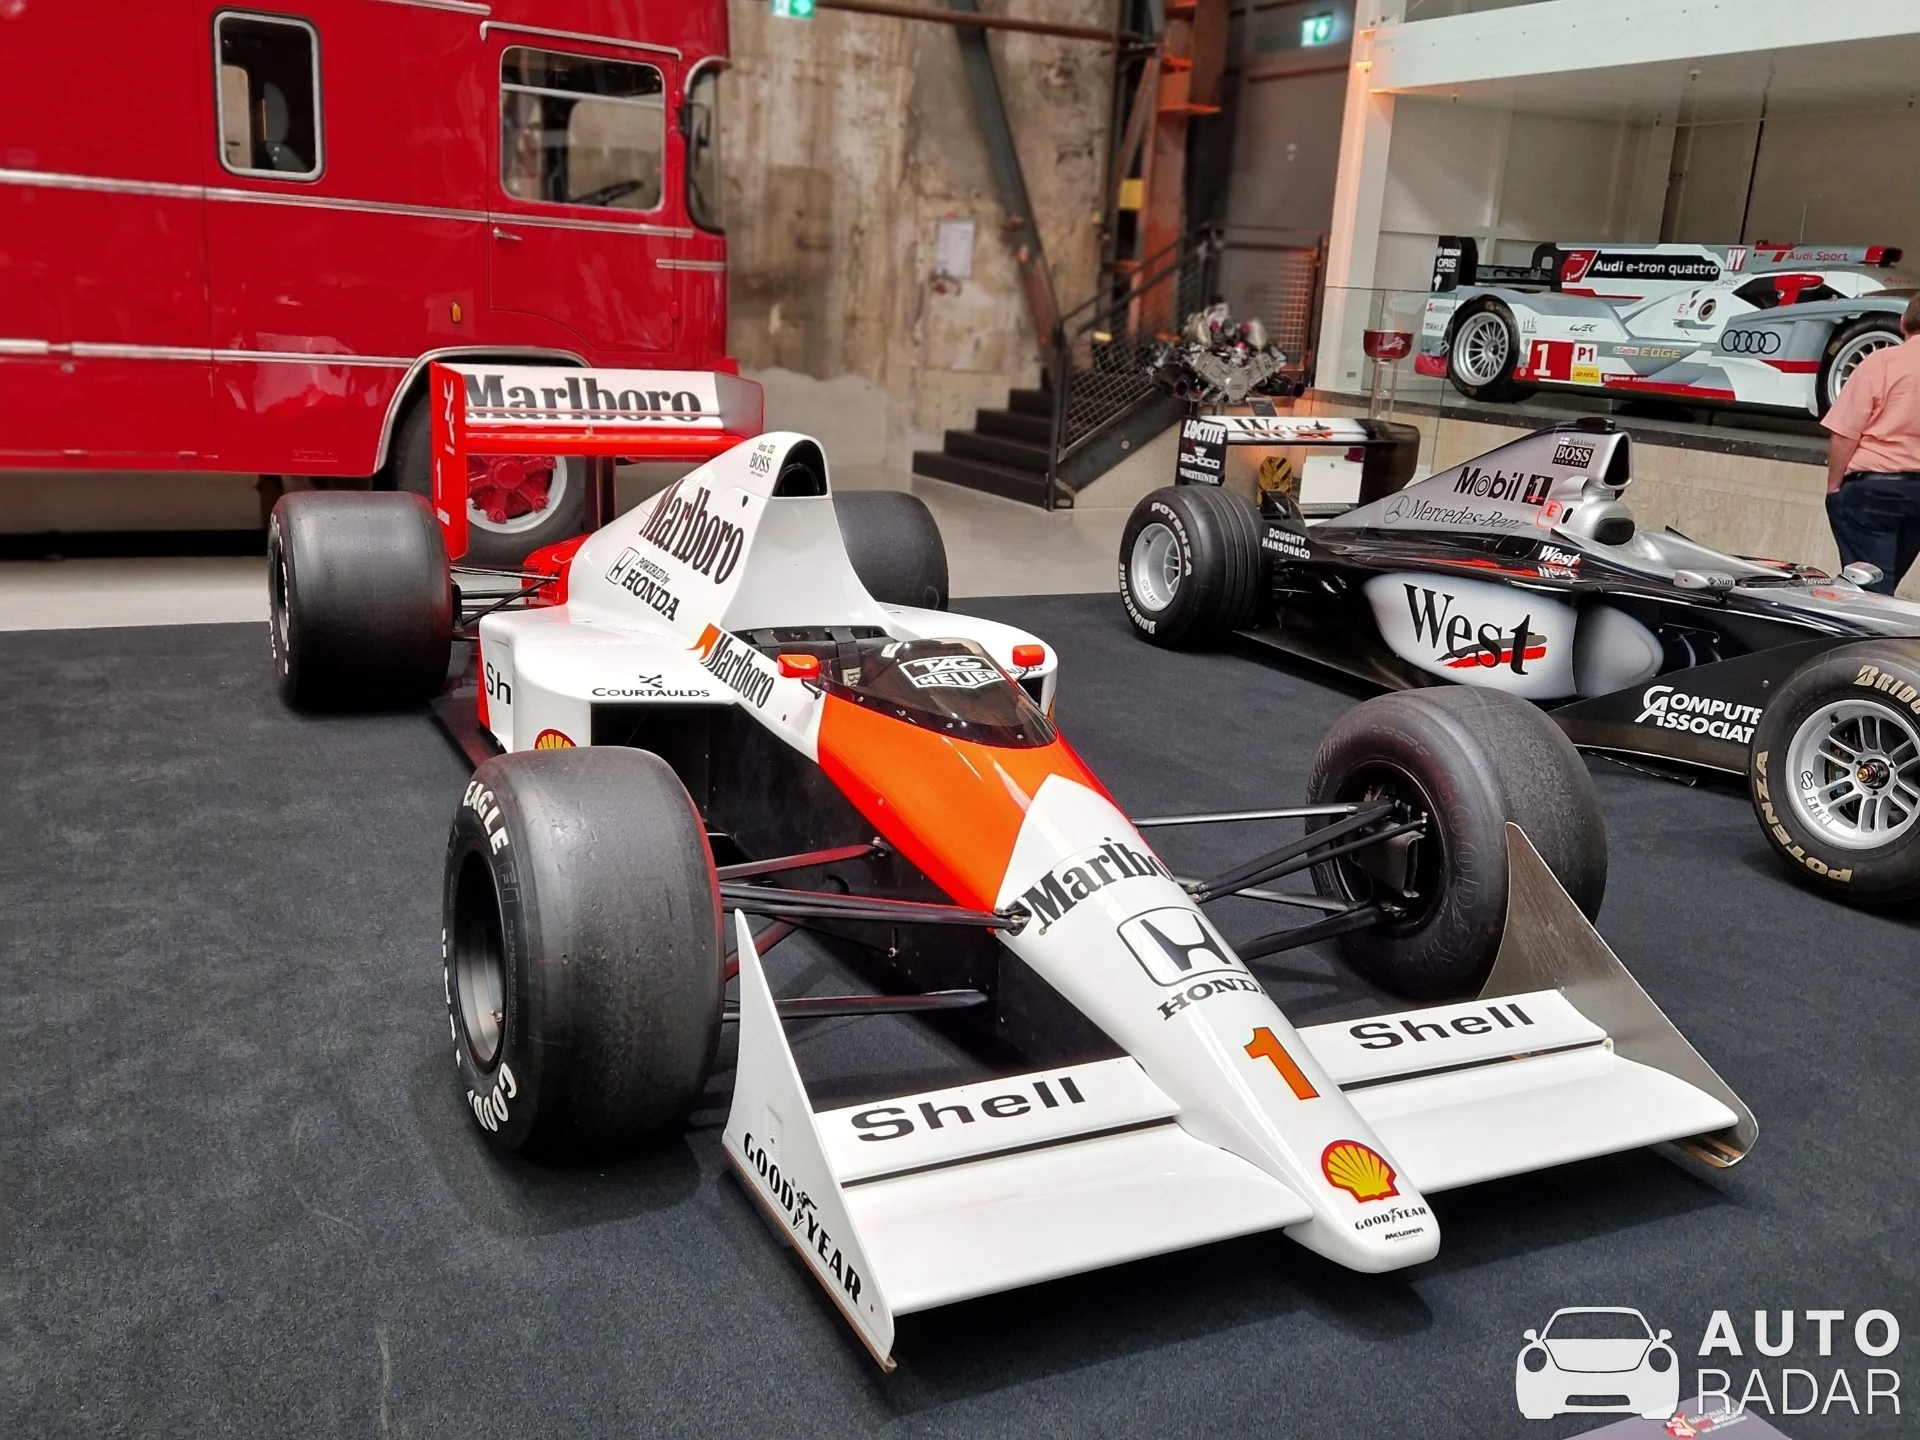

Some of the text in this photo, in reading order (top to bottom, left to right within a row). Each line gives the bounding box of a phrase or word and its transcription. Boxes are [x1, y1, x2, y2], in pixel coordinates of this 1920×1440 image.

[1437, 258, 1457, 268] ORIS
[1593, 260, 1624, 272] Audi
[1626, 261, 1666, 274] e-tron
[1668, 262, 1719, 276] quattro
[1724, 247, 1747, 271] HY
[1787, 251, 1849, 263] Audi Sport
[1677, 303, 1686, 314] E
[1533, 343, 1552, 377] 1
[1577, 346, 1594, 362] P1
[1639, 347, 1682, 359] EDGE
[465, 374, 702, 422] Marlboro
[1182, 419, 1226, 444] LOCTITE
[749, 452, 772, 473] BOSS
[1556, 445, 1591, 462] BOSS
[1453, 466, 1524, 502] Mobil
[1406, 500, 1532, 529] Mercedes-Benz
[638, 479, 744, 584] Marlboro
[1151, 502, 1193, 577] POTENZA
[1268, 528, 1307, 546] DOUGHTY
[1262, 537, 1311, 560] HANSON&CO
[1538, 545, 1582, 567] West
[635, 557, 667, 582] POWERED
[1716, 577, 1734, 587] Sun
[621, 568, 681, 622] HONDA
[1403, 583, 1536, 676] West
[701, 633, 775, 709] Marlboro
[913, 657, 982, 673] TAG
[918, 670, 998, 686] HEUER
[591, 687, 711, 698] COURTAULDS
[463, 780, 510, 856] EAGLE
[1756, 750, 1853, 883] POTENZA
[1350, 1003, 1535, 1050] Shell
[1243, 1027, 1321, 1101] 1
[850, 1077, 1086, 1142] Shell
[1354, 1207, 1428, 1230] GOODYEAR
[1385, 1227, 1424, 1240] McLaren
